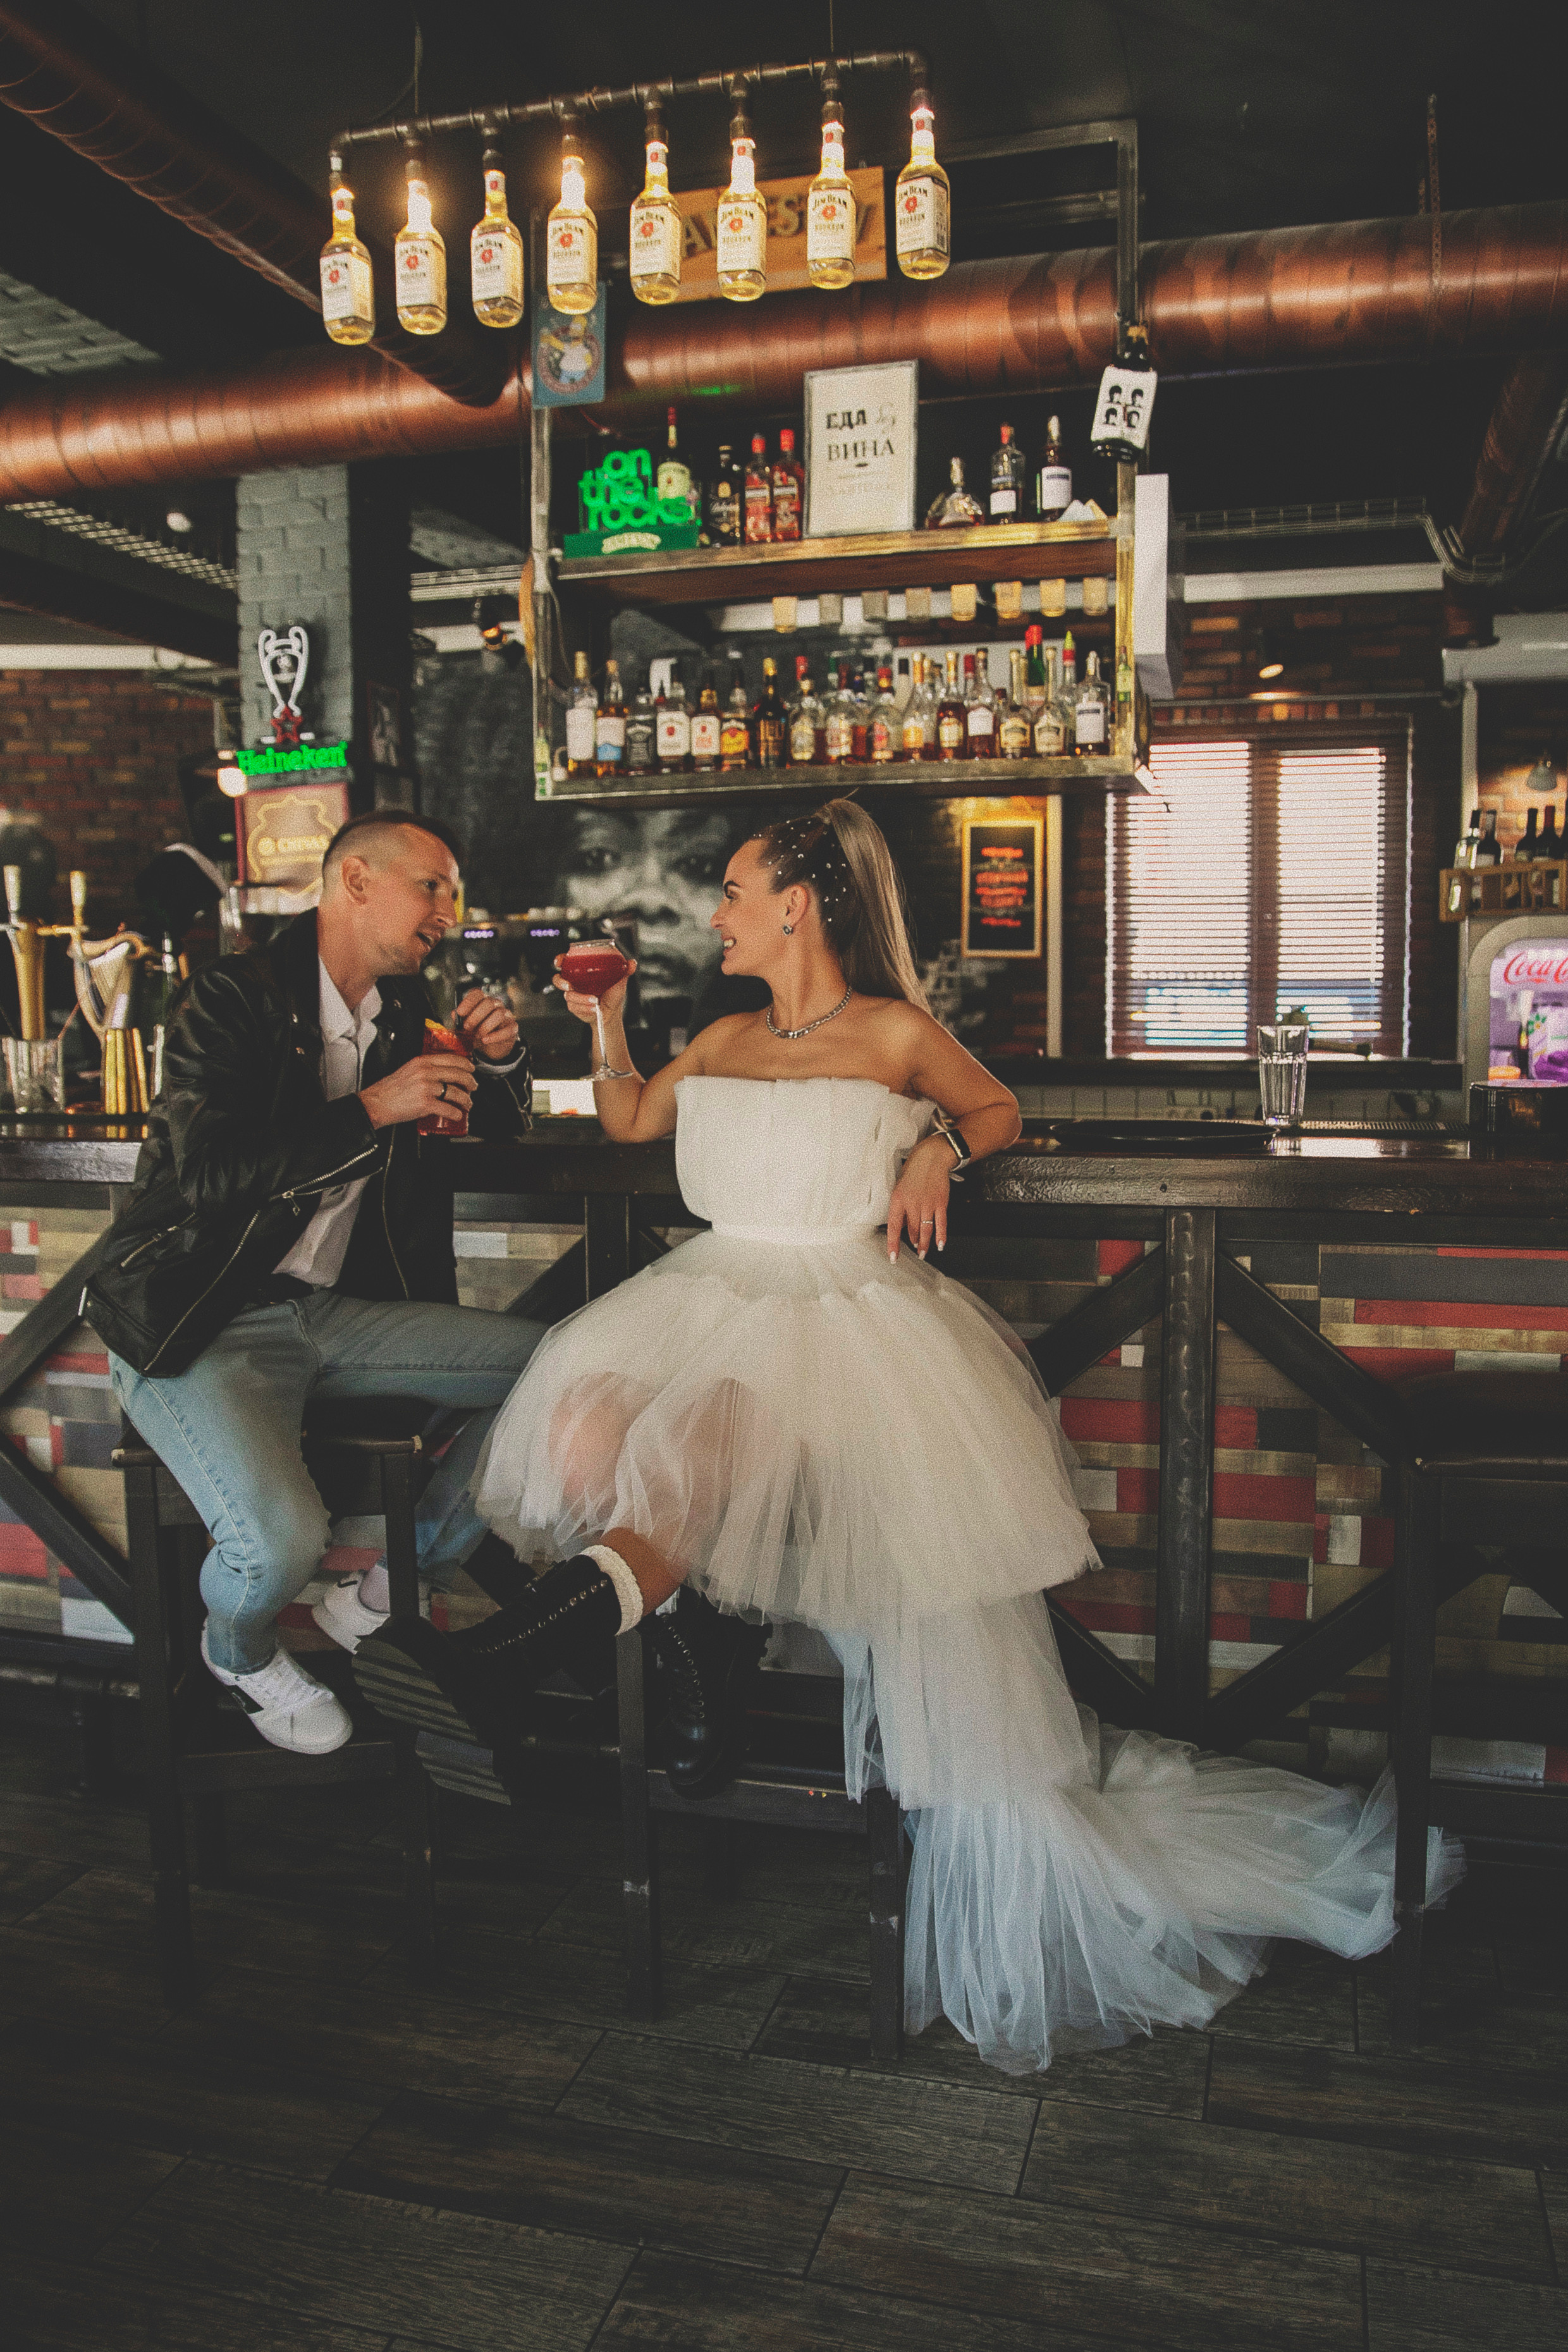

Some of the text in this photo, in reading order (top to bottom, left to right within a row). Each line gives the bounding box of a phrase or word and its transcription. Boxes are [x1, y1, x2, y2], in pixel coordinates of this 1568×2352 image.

[827, 193, 847, 209] BEAM
[909, 185, 928, 197] BEAM
[645, 211, 665, 224] BEAM
[734, 206, 754, 220] BEAM
[825, 408, 867, 430] ЕДА
[827, 438, 895, 462] ВИНА
[603, 448, 652, 479] on
[578, 467, 644, 506] the
[236, 742, 348, 776] Heineken
